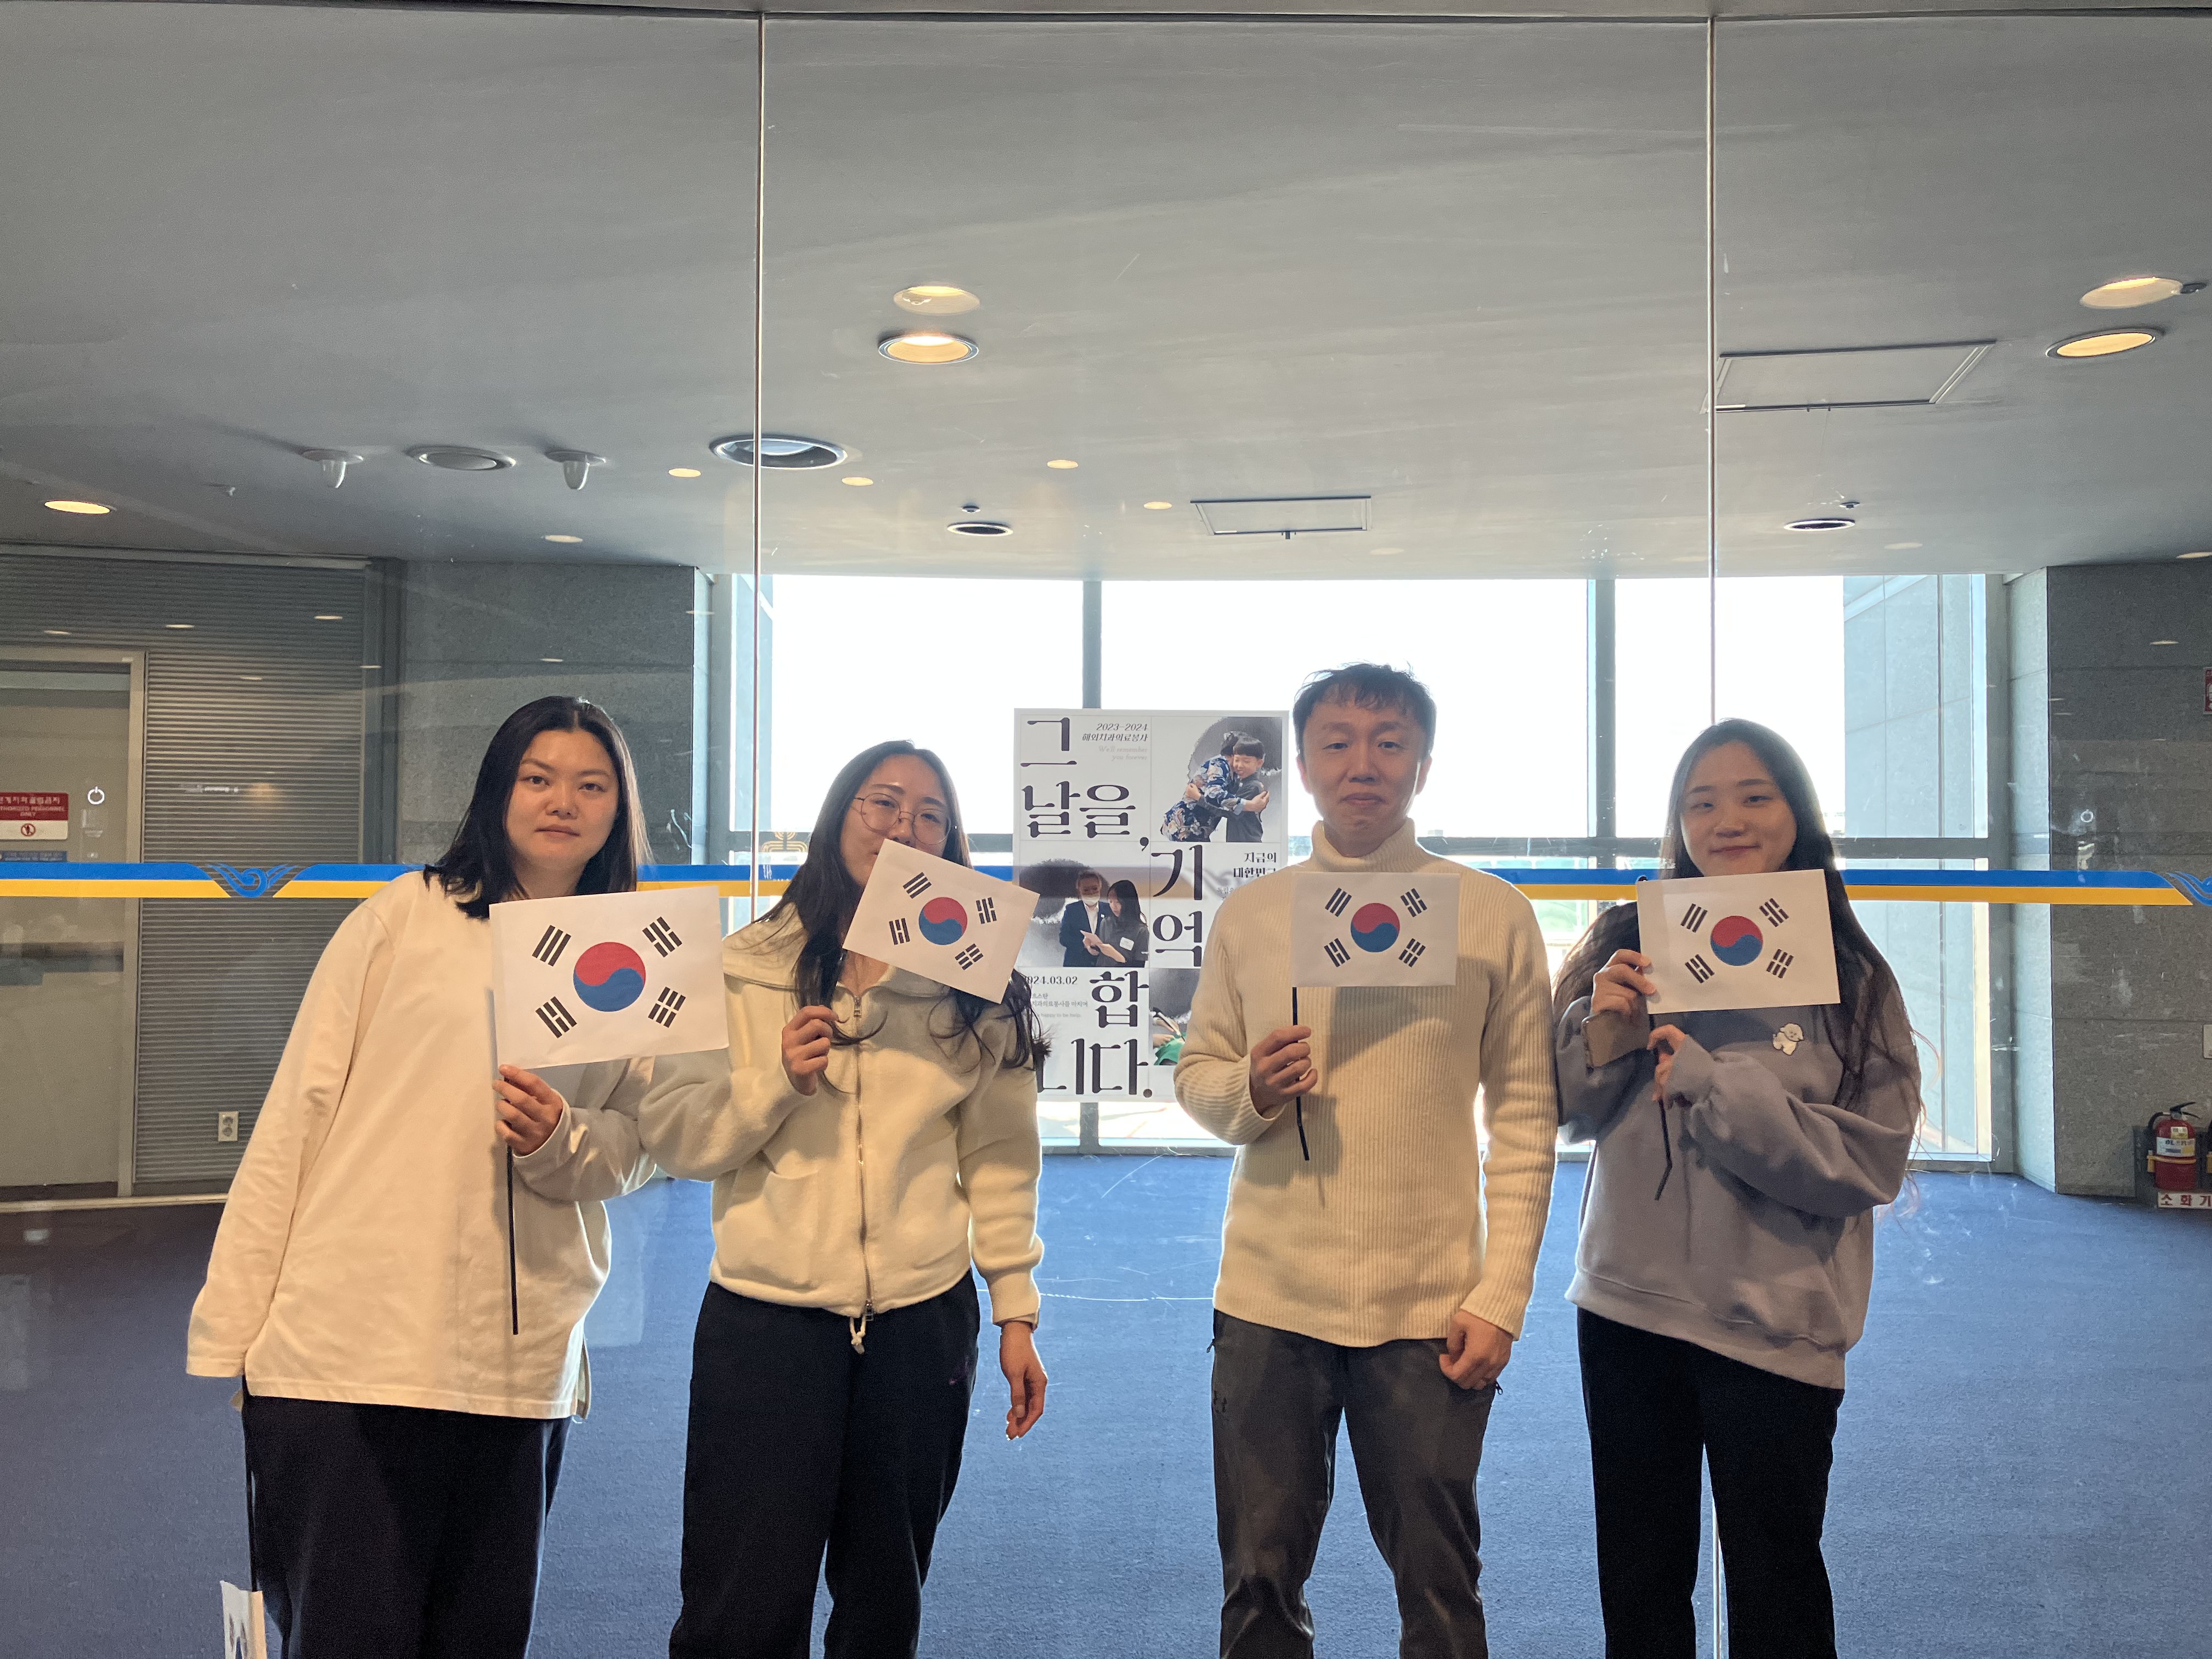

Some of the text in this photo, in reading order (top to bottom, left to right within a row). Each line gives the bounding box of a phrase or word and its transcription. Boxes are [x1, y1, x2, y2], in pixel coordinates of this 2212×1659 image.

[1096, 723, 1148, 731] 2023-2024
[1020, 717, 1077, 767] 그
[1082, 733, 1148, 742] 해외치과의료봉사
[1022, 781, 1149, 851] 날을,
[1244, 852, 1277, 863] 지금의
[1026, 976, 1077, 985] 024.03.02
